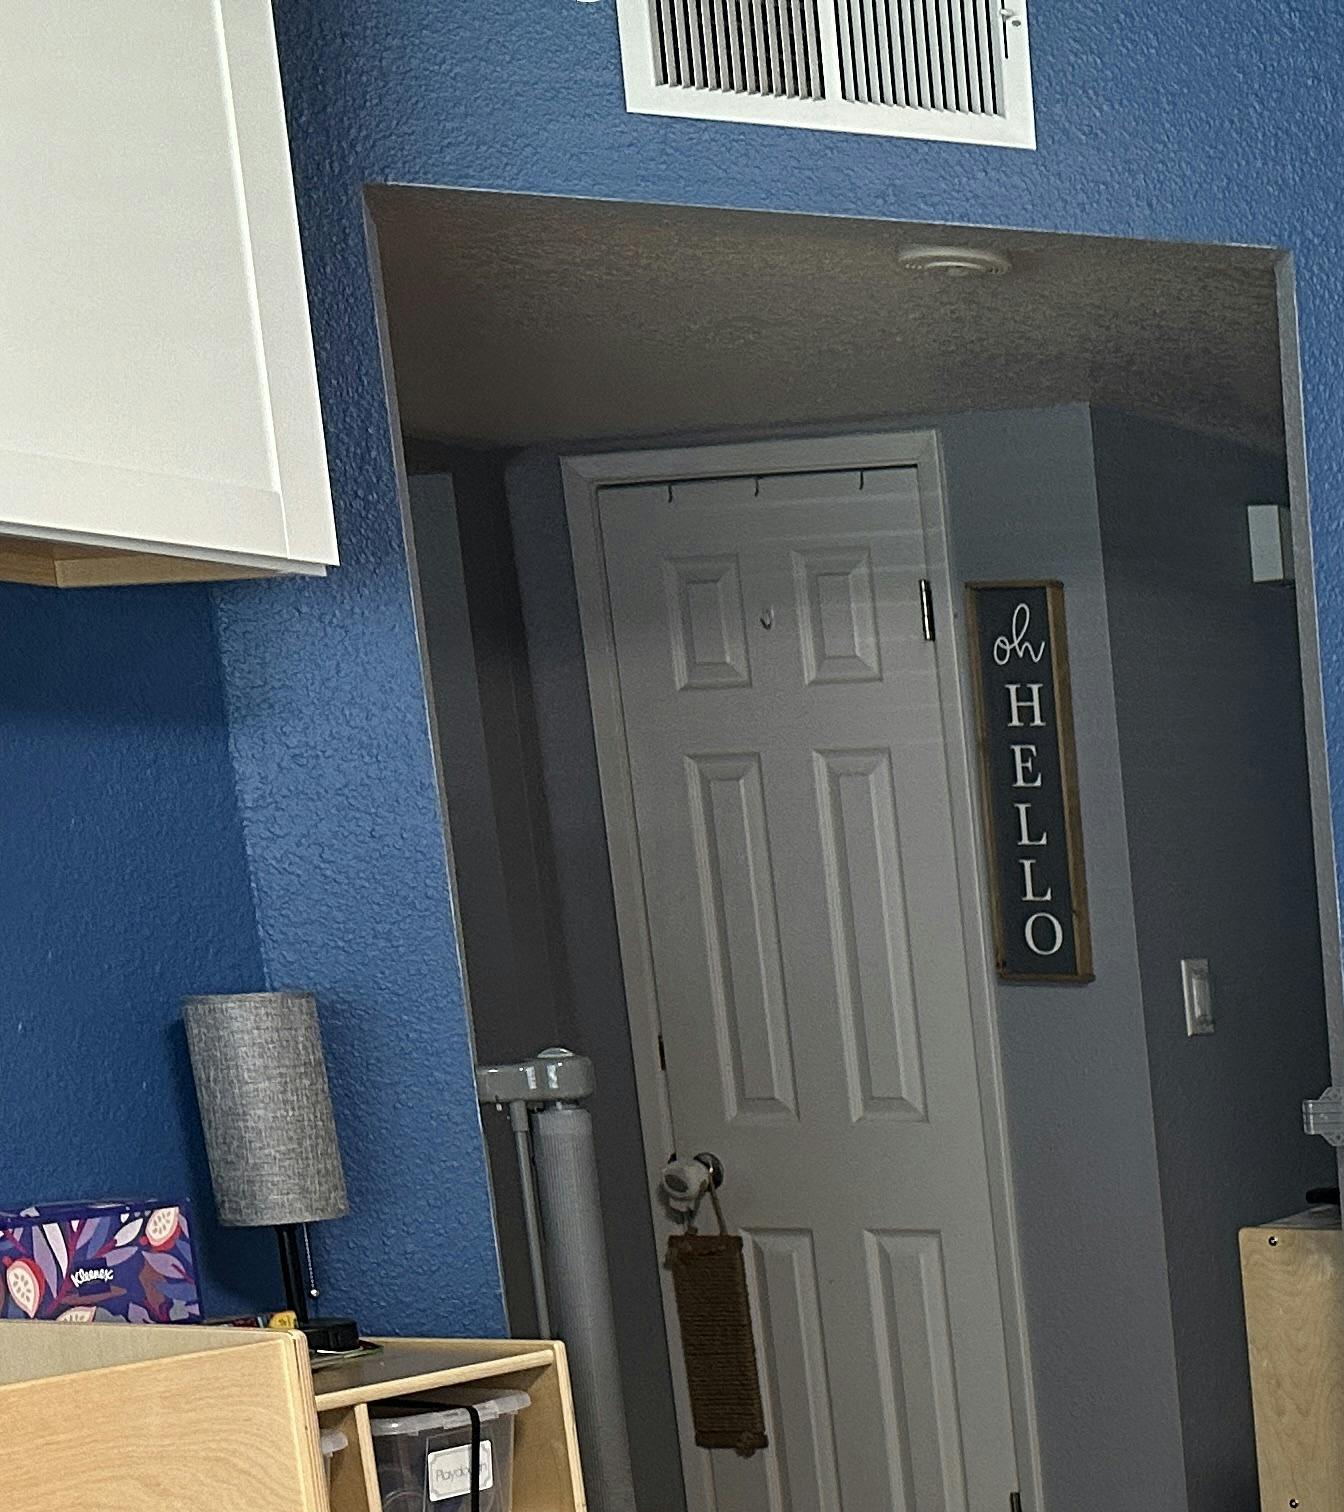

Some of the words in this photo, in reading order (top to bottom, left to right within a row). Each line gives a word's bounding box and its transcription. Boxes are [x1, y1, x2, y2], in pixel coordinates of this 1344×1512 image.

[993, 603, 1045, 666] oh
[1005, 683, 1064, 955] HELLO
[70, 1268, 114, 1288] Kleenex
